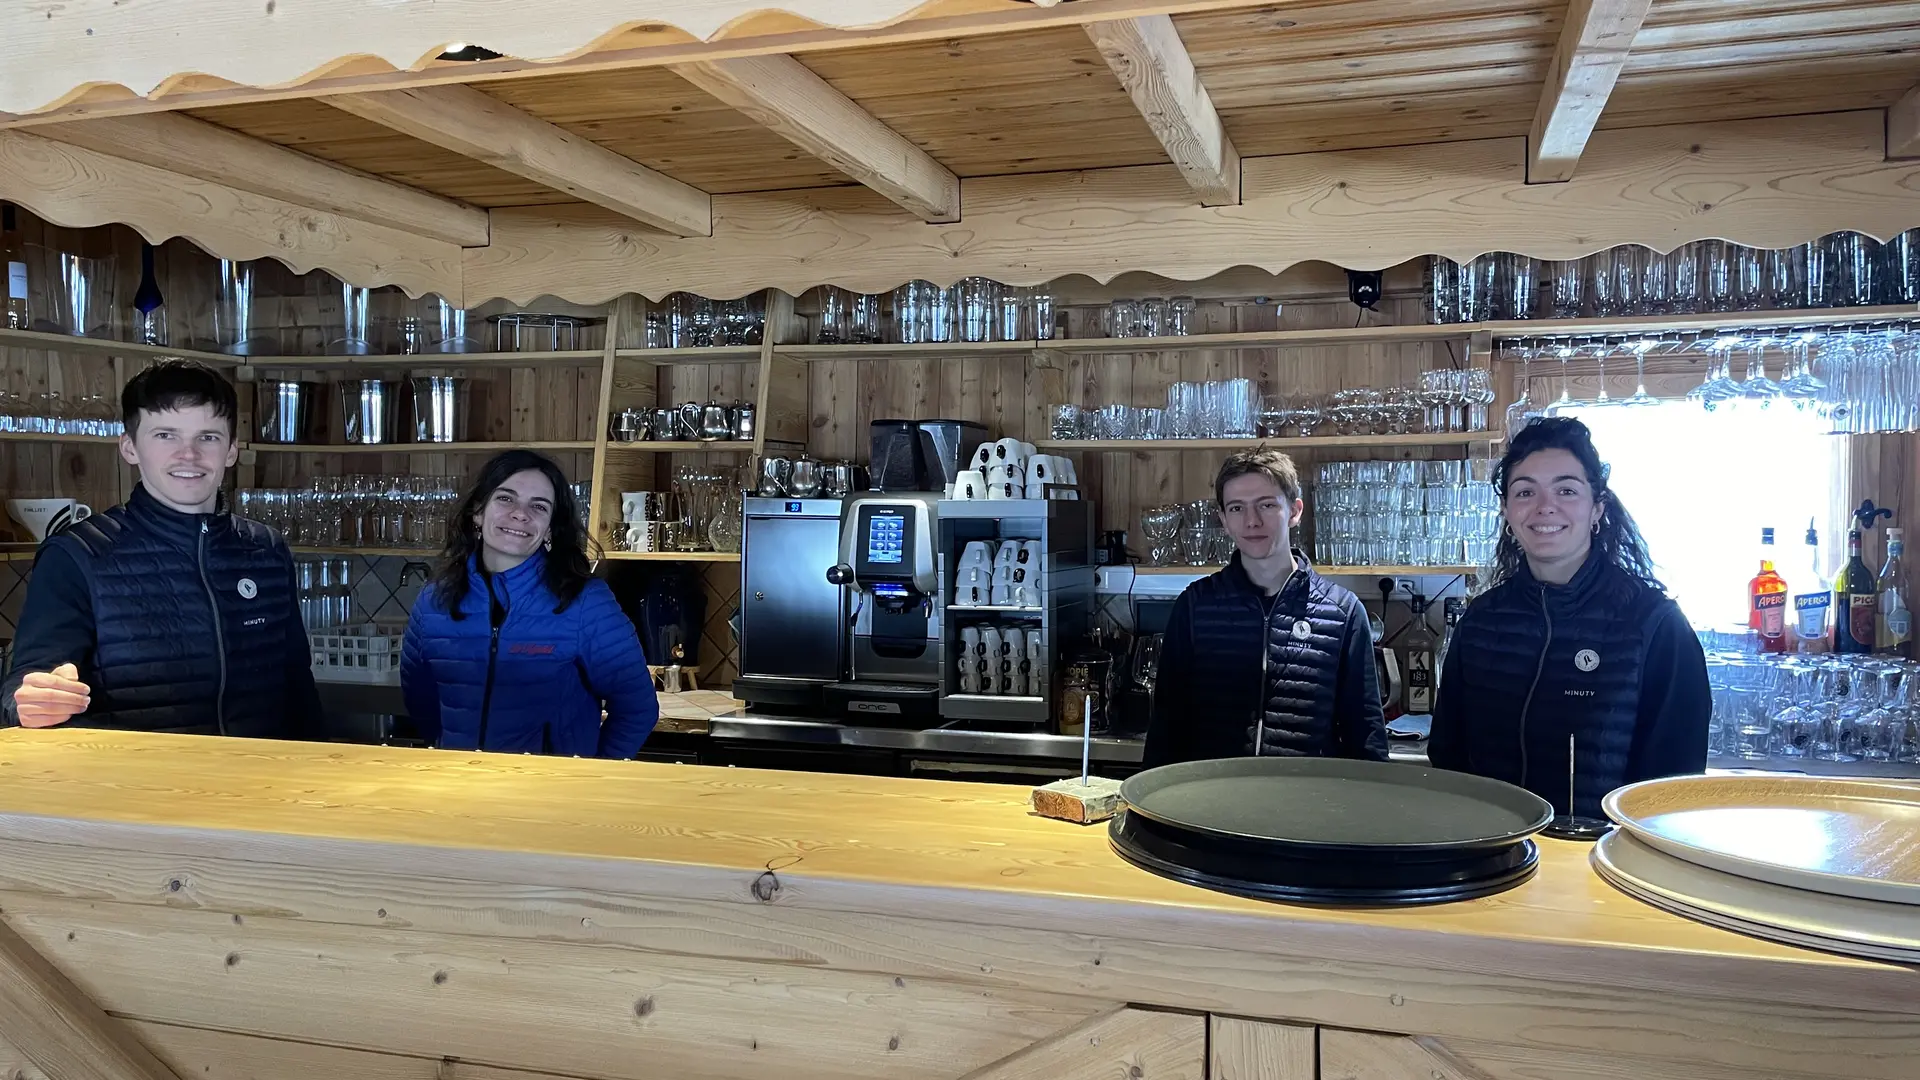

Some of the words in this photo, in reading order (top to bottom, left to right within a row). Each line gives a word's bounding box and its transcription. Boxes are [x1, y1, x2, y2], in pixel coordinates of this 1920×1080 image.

[1796, 595, 1828, 608] APEROL
[1287, 641, 1312, 649] MINUTY
[1564, 689, 1596, 697] MINUTY
